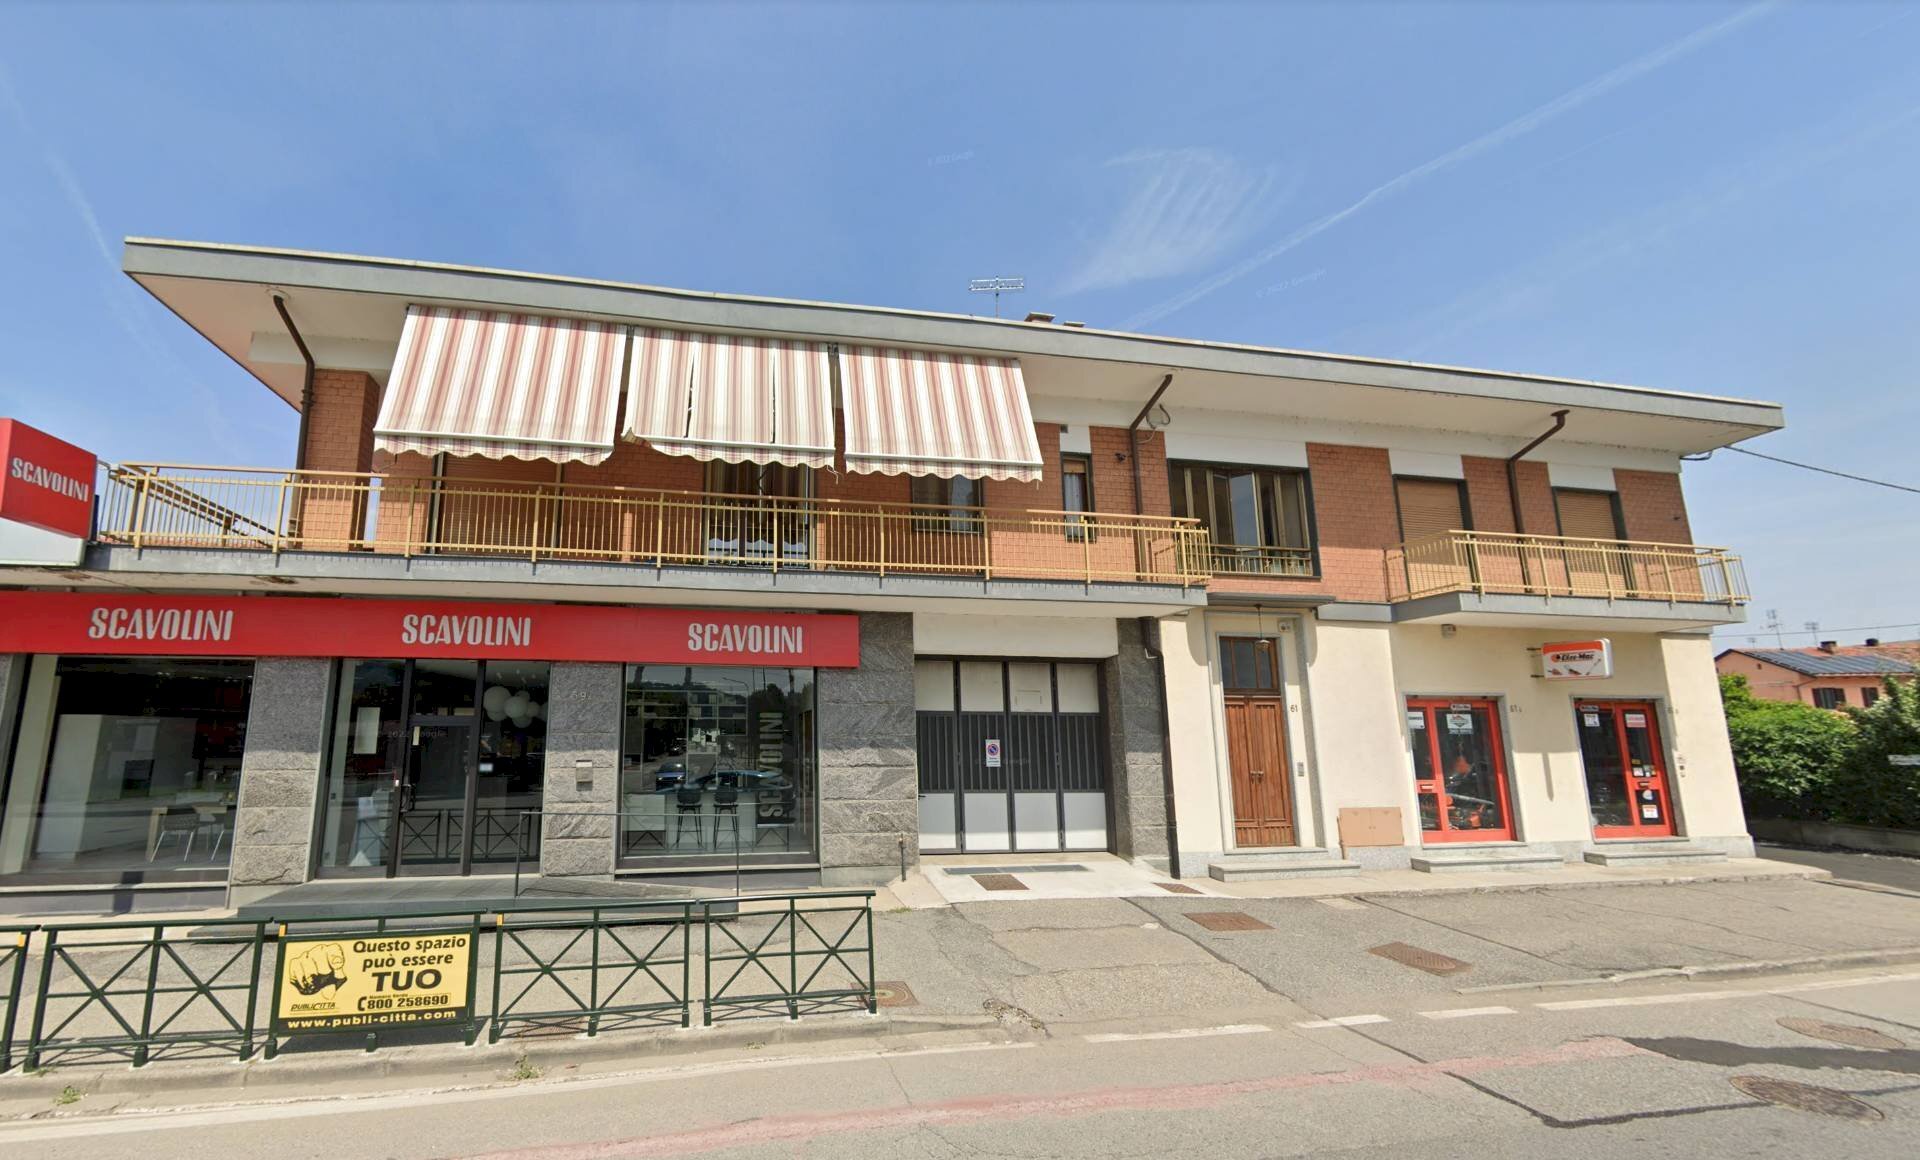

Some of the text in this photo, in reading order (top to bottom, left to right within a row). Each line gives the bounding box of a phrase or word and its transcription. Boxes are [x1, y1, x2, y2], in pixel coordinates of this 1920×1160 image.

[11, 457, 89, 502] SCAVOLINI
[88, 608, 234, 641] SCAVOLINI
[401, 614, 531, 647] SCAVOLINI
[688, 623, 803, 654] SCAVOLINI
[353, 936, 466, 954] Questo spazio
[362, 954, 454, 972] può essere
[371, 969, 442, 992] TUO
[367, 995, 449, 1009] 800 258690
[287, 1010, 457, 1029] www.publi-citta.com
